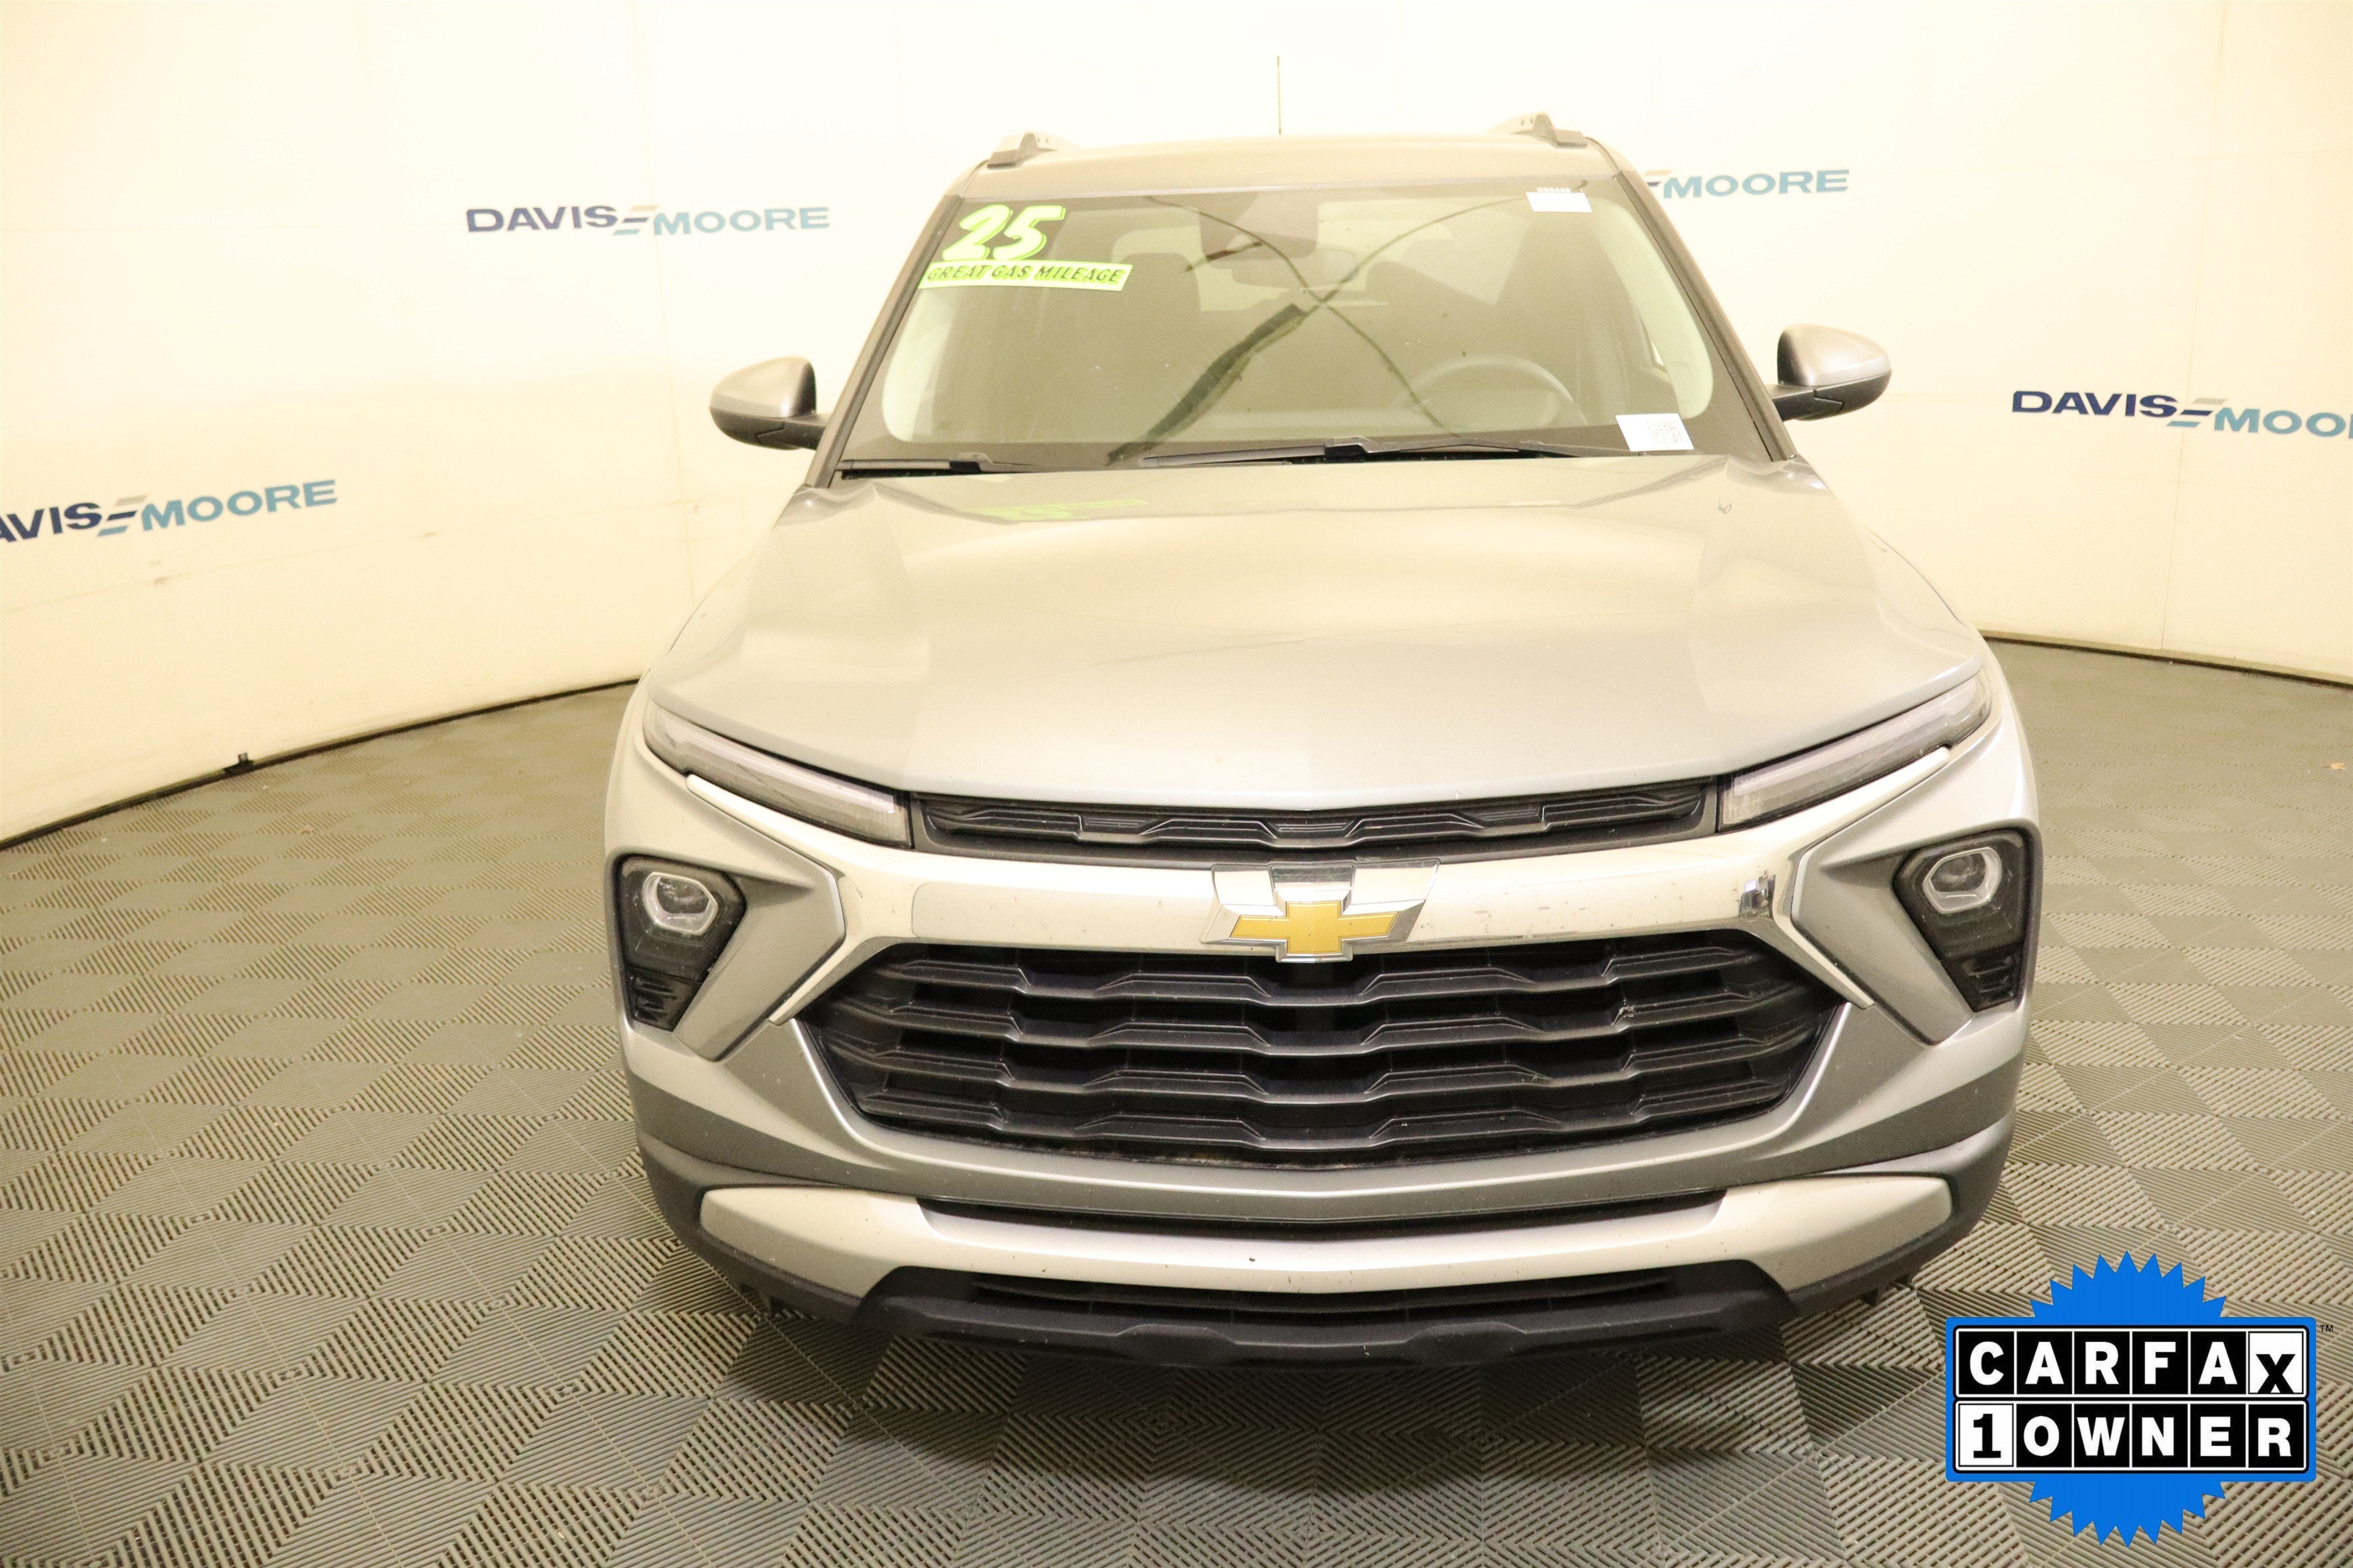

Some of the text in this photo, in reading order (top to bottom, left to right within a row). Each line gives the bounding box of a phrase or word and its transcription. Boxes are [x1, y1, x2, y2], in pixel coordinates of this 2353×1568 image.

[1663, 169, 1850, 199] MOORE
[466, 206, 831, 235] DAVIS MOORE
[942, 204, 1066, 261] 25
[927, 265, 1126, 284] GREAT GAS MILEAGE
[2012, 391, 2353, 440] DAVIS MOO
[141, 479, 338, 531] MOORE
